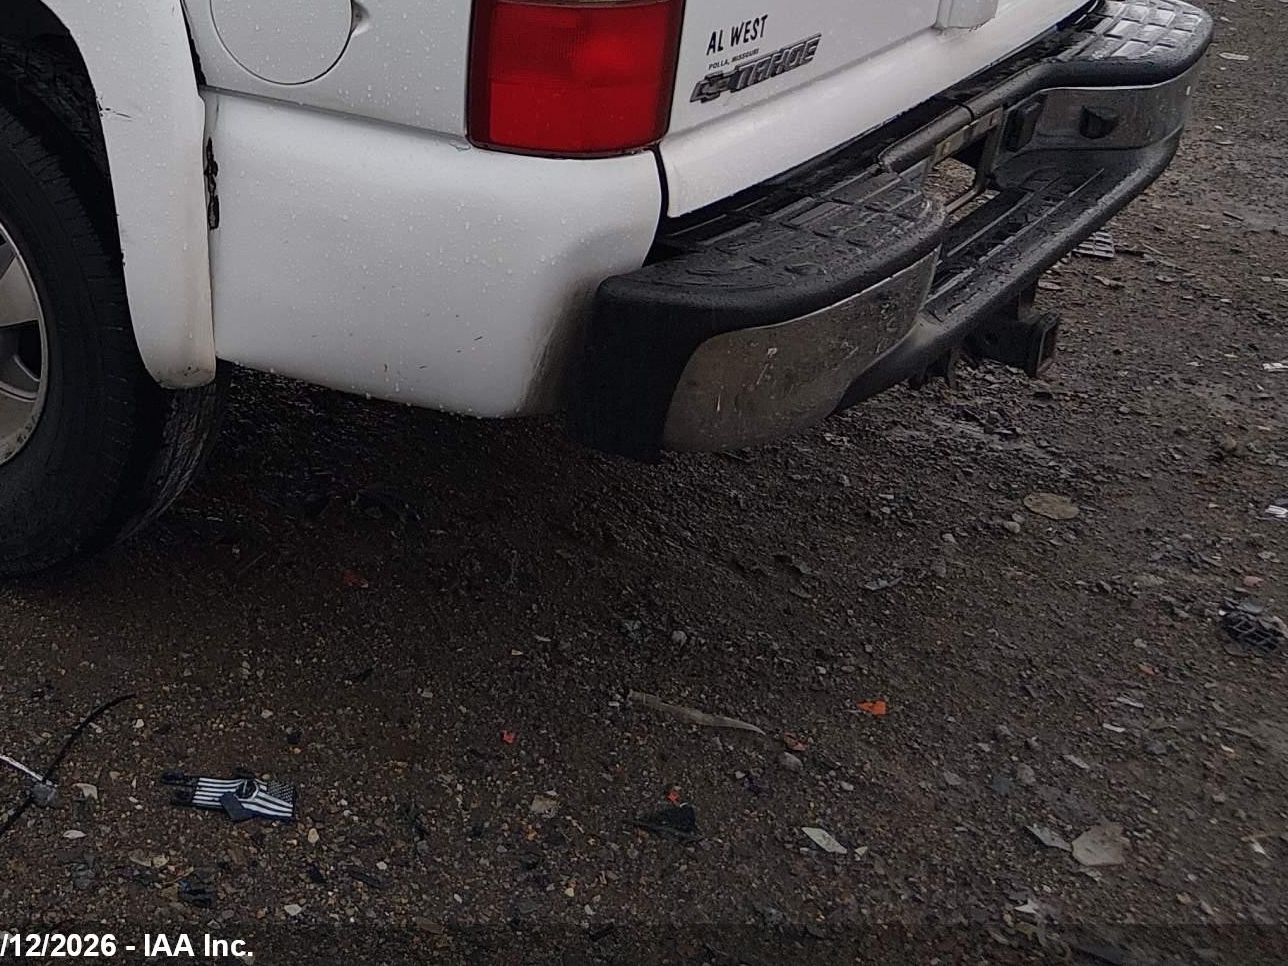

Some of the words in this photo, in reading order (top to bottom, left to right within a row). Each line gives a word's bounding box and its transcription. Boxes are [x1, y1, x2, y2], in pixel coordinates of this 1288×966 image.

[706, 29, 724, 56] AL
[730, 14, 769, 47] WEST
[732, 34, 822, 92] TAHOE
